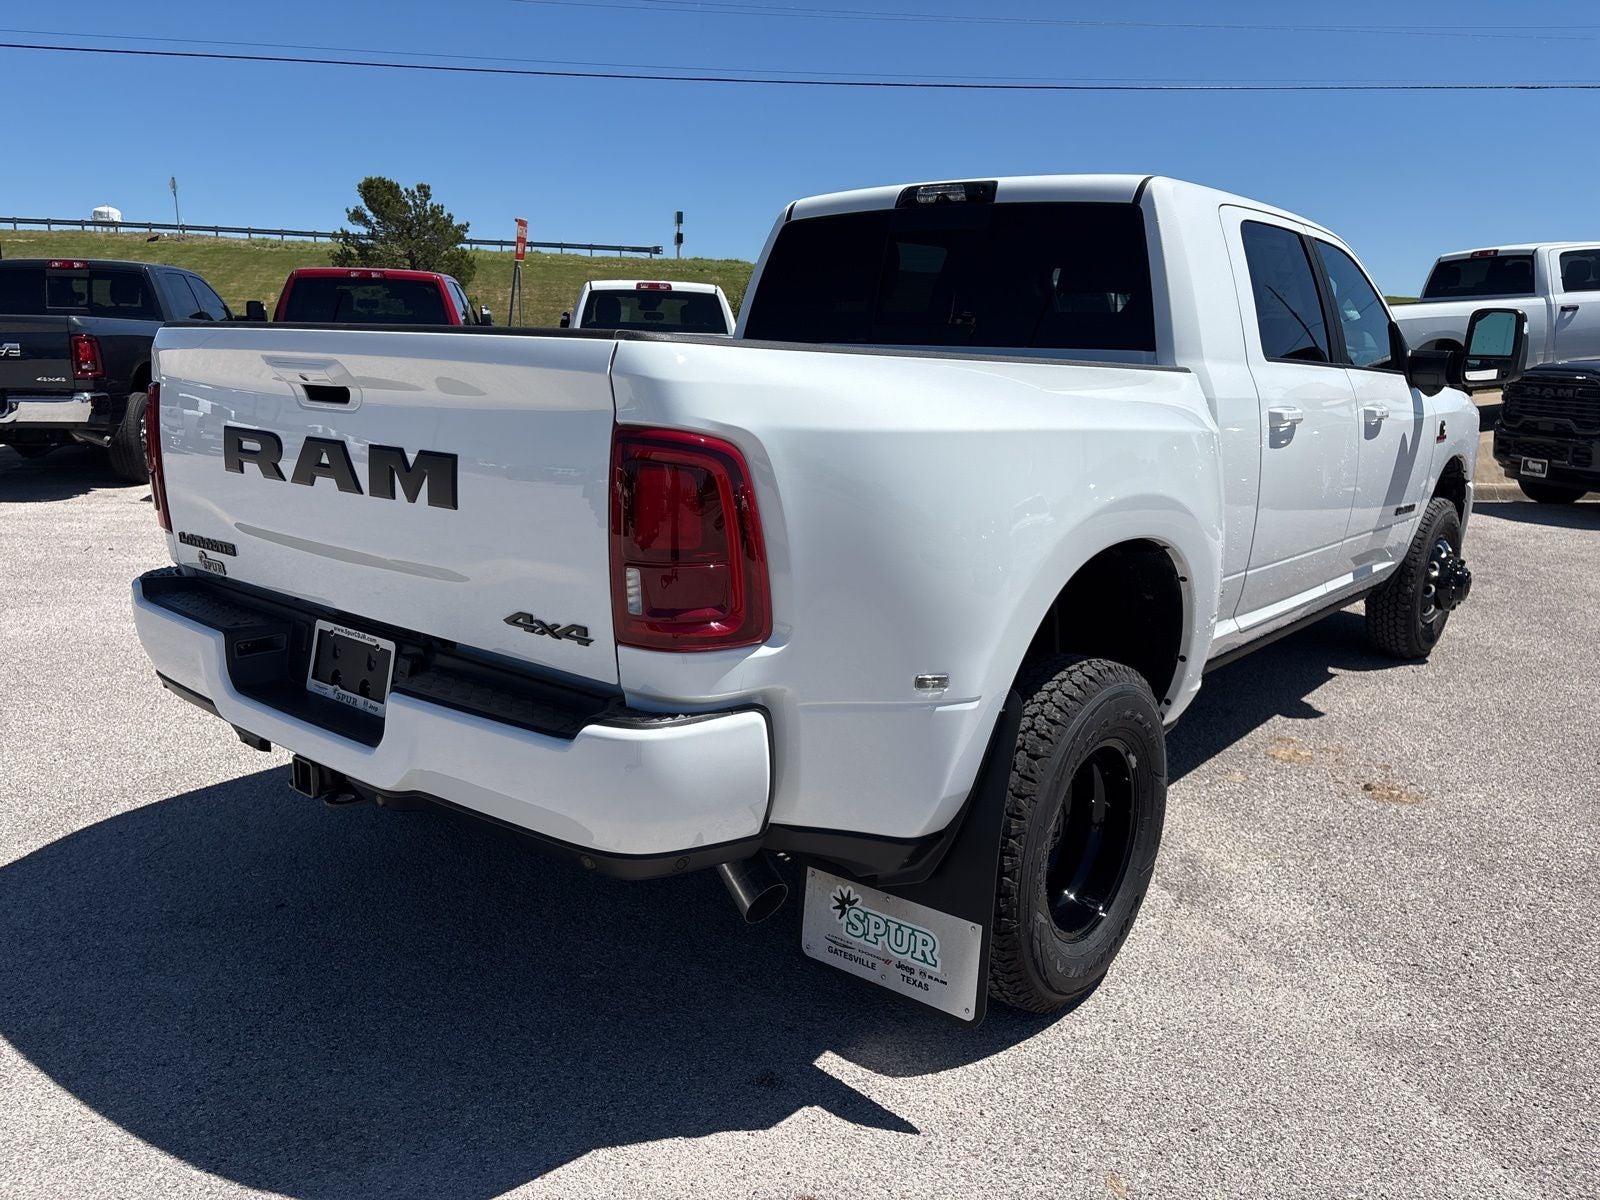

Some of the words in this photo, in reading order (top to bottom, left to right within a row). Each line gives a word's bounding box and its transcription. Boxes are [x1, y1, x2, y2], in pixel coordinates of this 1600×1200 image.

[1526, 386, 1573, 398] RAM
[223, 425, 458, 510] RAM
[203, 559, 225, 574] SPUR
[503, 611, 595, 647] 4x4
[336, 692, 358, 706] SPUR
[846, 906, 938, 968] SPUR
[827, 945, 877, 971] GATESVILLE
[900, 974, 930, 992] TEXAS
[895, 960, 915, 976] Jeep
[927, 974, 948, 986] RAM
